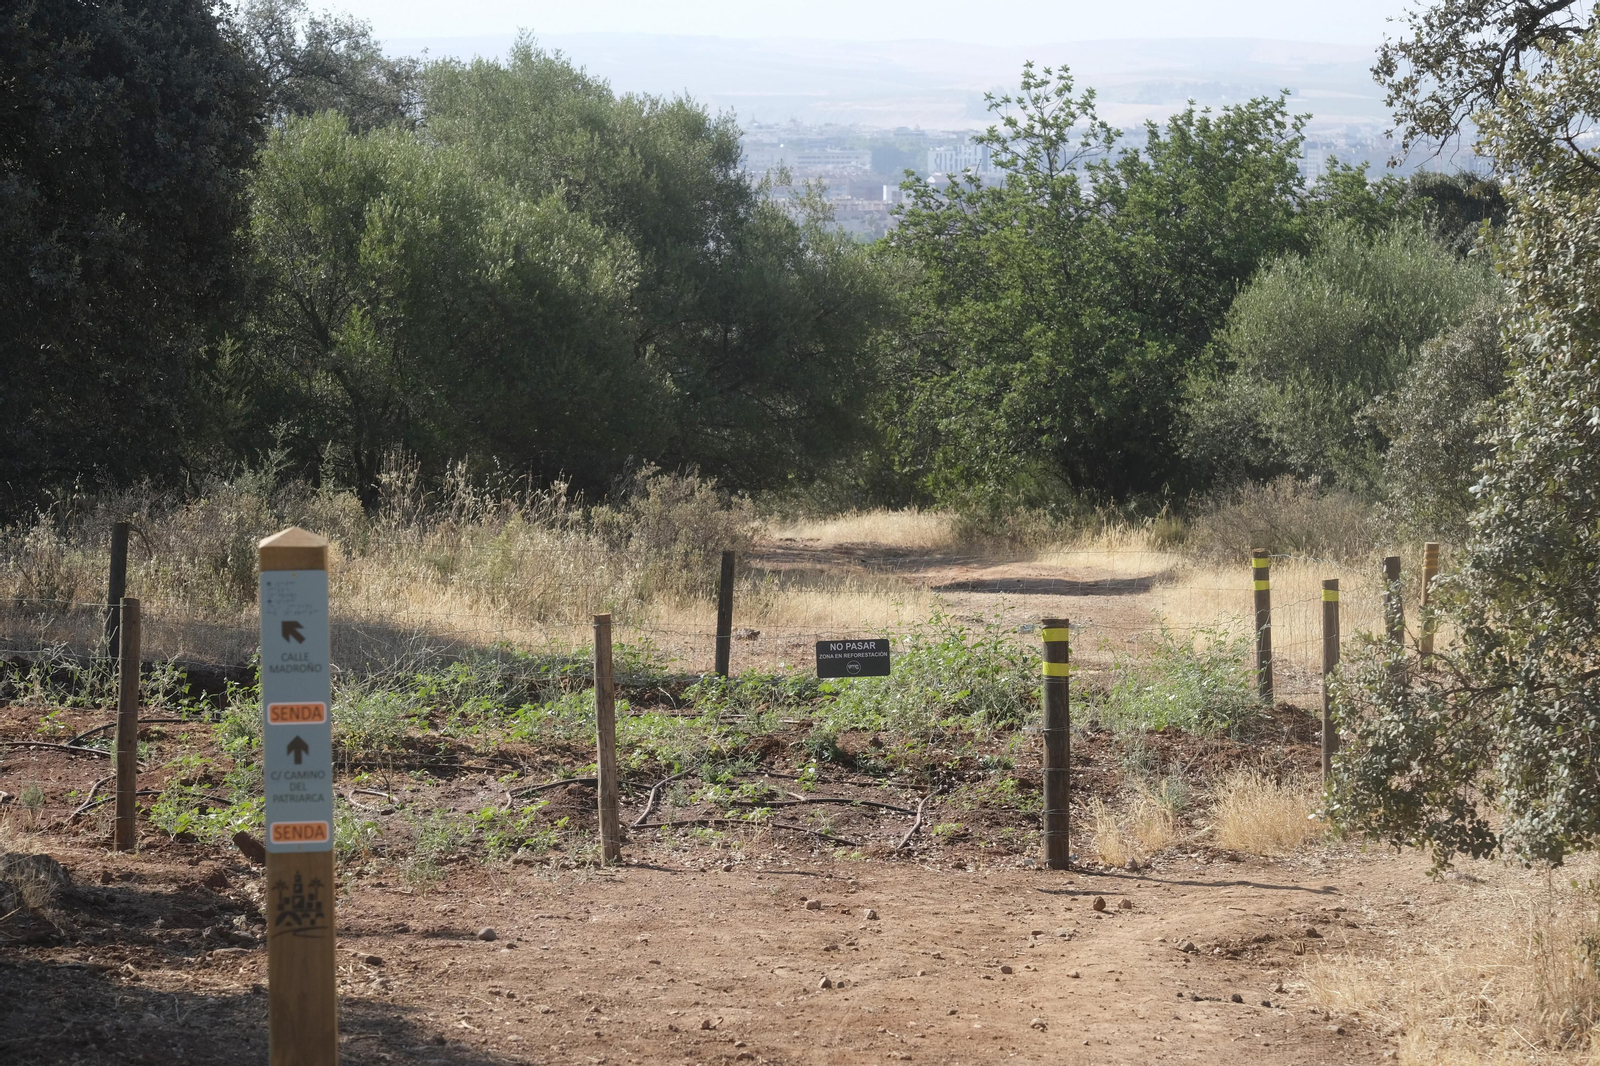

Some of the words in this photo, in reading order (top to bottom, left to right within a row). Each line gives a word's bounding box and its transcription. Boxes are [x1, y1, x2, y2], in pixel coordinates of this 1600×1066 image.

[830, 643, 843, 651] NO
[846, 642, 876, 650] PASAR
[281, 652, 309, 662] CALLE
[269, 662, 322, 674] MADROÑO
[271, 706, 322, 721] SENDA
[271, 771, 282, 781] C/
[284, 770, 325, 780] CAMINO
[289, 782, 307, 791] DEL
[273, 793, 324, 803] PATRIARCA
[274, 825, 324, 840] SENDA
